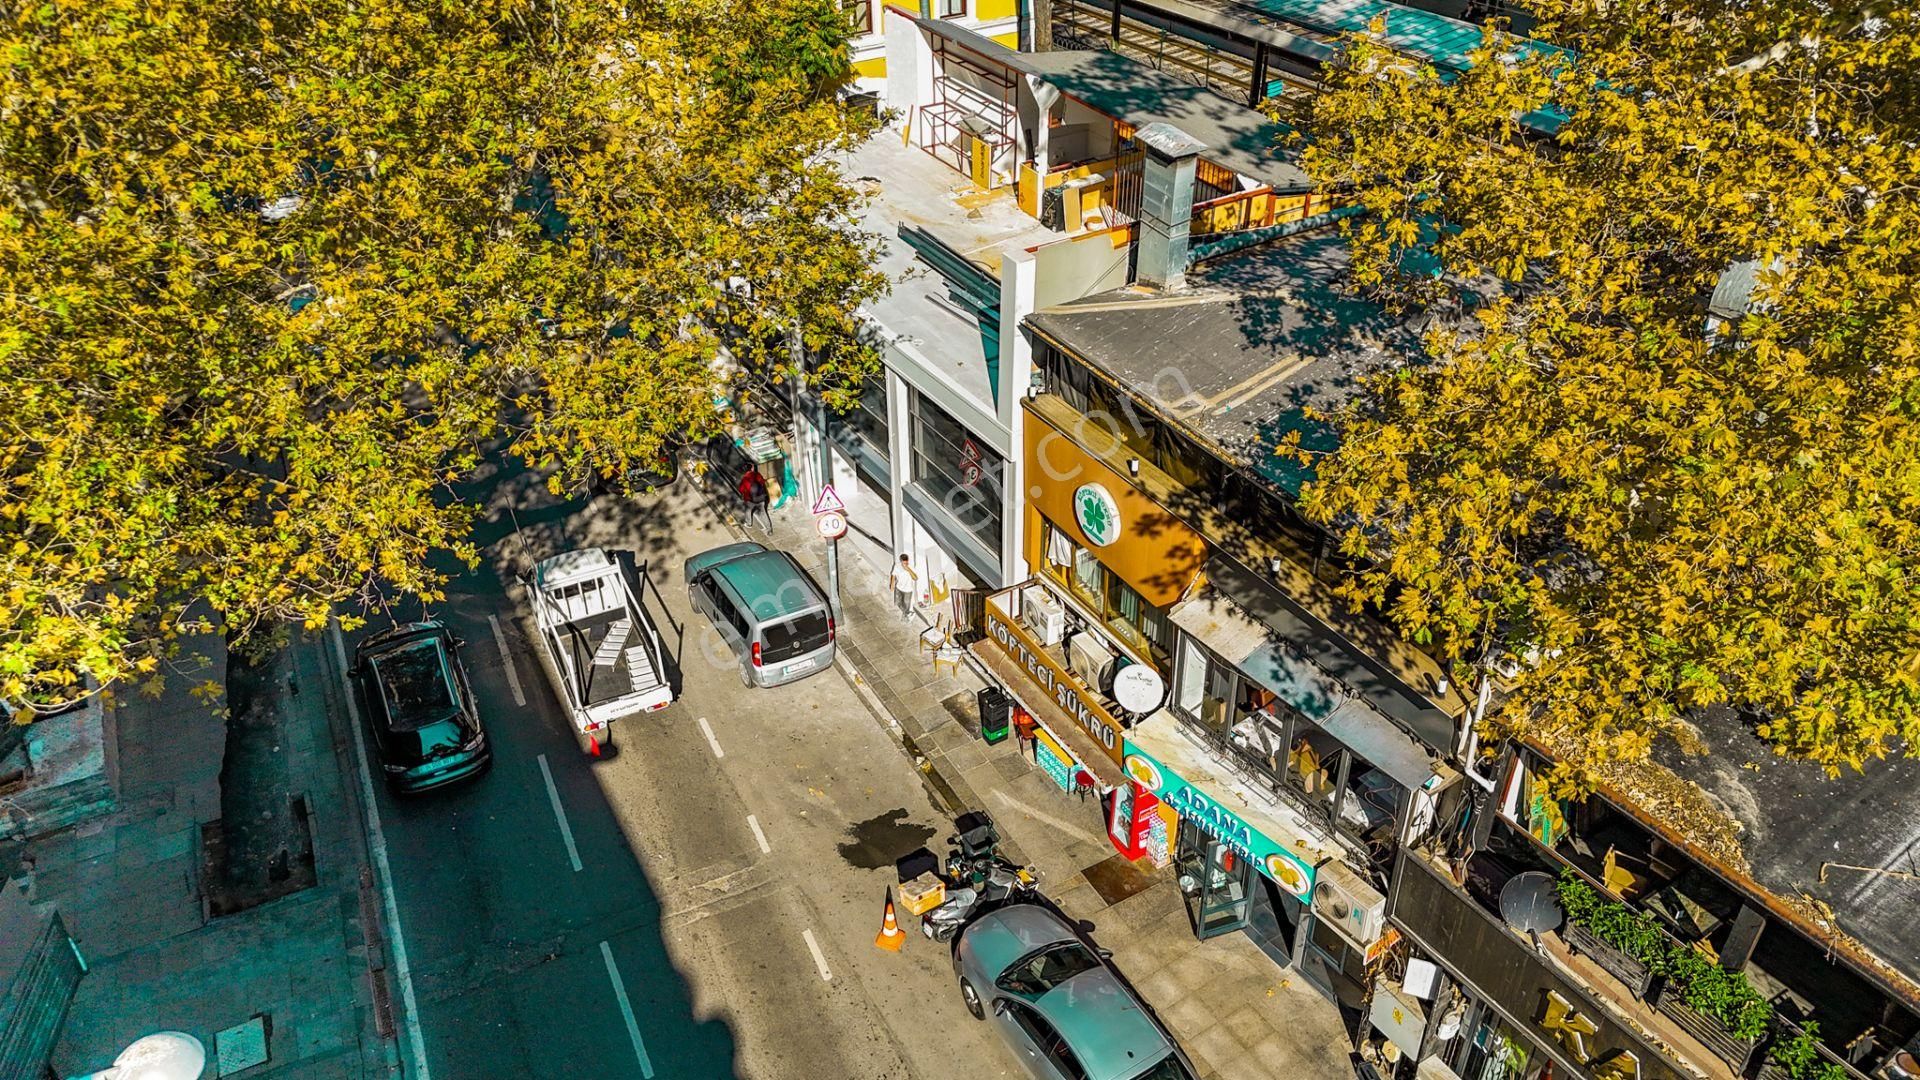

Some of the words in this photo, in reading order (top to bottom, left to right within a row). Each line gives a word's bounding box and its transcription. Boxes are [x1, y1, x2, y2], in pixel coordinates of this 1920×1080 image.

[823, 518, 840, 531] 30
[988, 614, 1054, 691] KÖFTECİ
[1056, 682, 1114, 750] ŞÜKRÜ
[1177, 786, 1251, 846] ADANA
[1223, 836, 1265, 870] KEBAP
